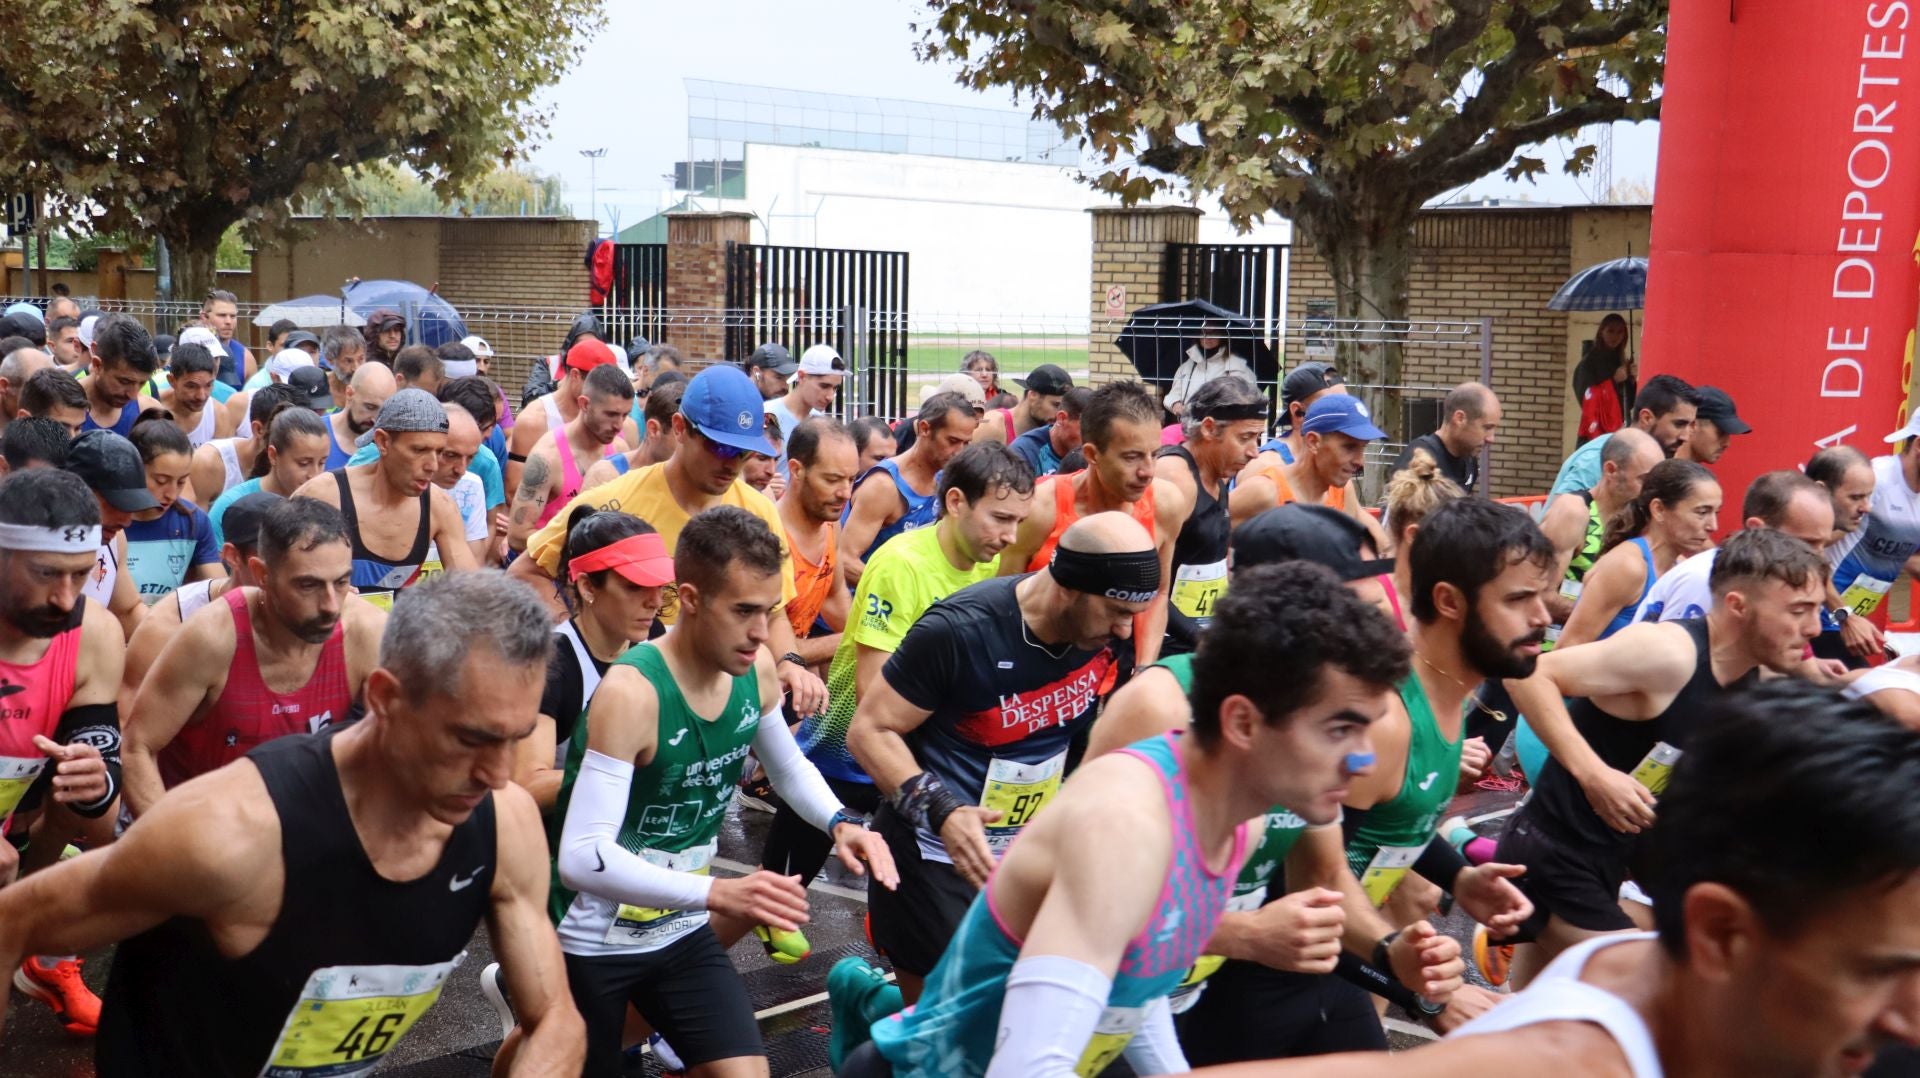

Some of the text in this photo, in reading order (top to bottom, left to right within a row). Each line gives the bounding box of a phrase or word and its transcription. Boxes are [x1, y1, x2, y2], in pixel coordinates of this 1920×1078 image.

[1832, 0, 1909, 298] DEPORTES
[1820, 326, 1869, 397] DE
[866, 592, 893, 622] 3R
[1195, 588, 1219, 616] 47
[999, 692, 1023, 711] LA
[1001, 669, 1098, 729] DESPENSA
[1028, 714, 1050, 734] DE
[1007, 792, 1044, 825] 92
[332, 1013, 406, 1061] 46
